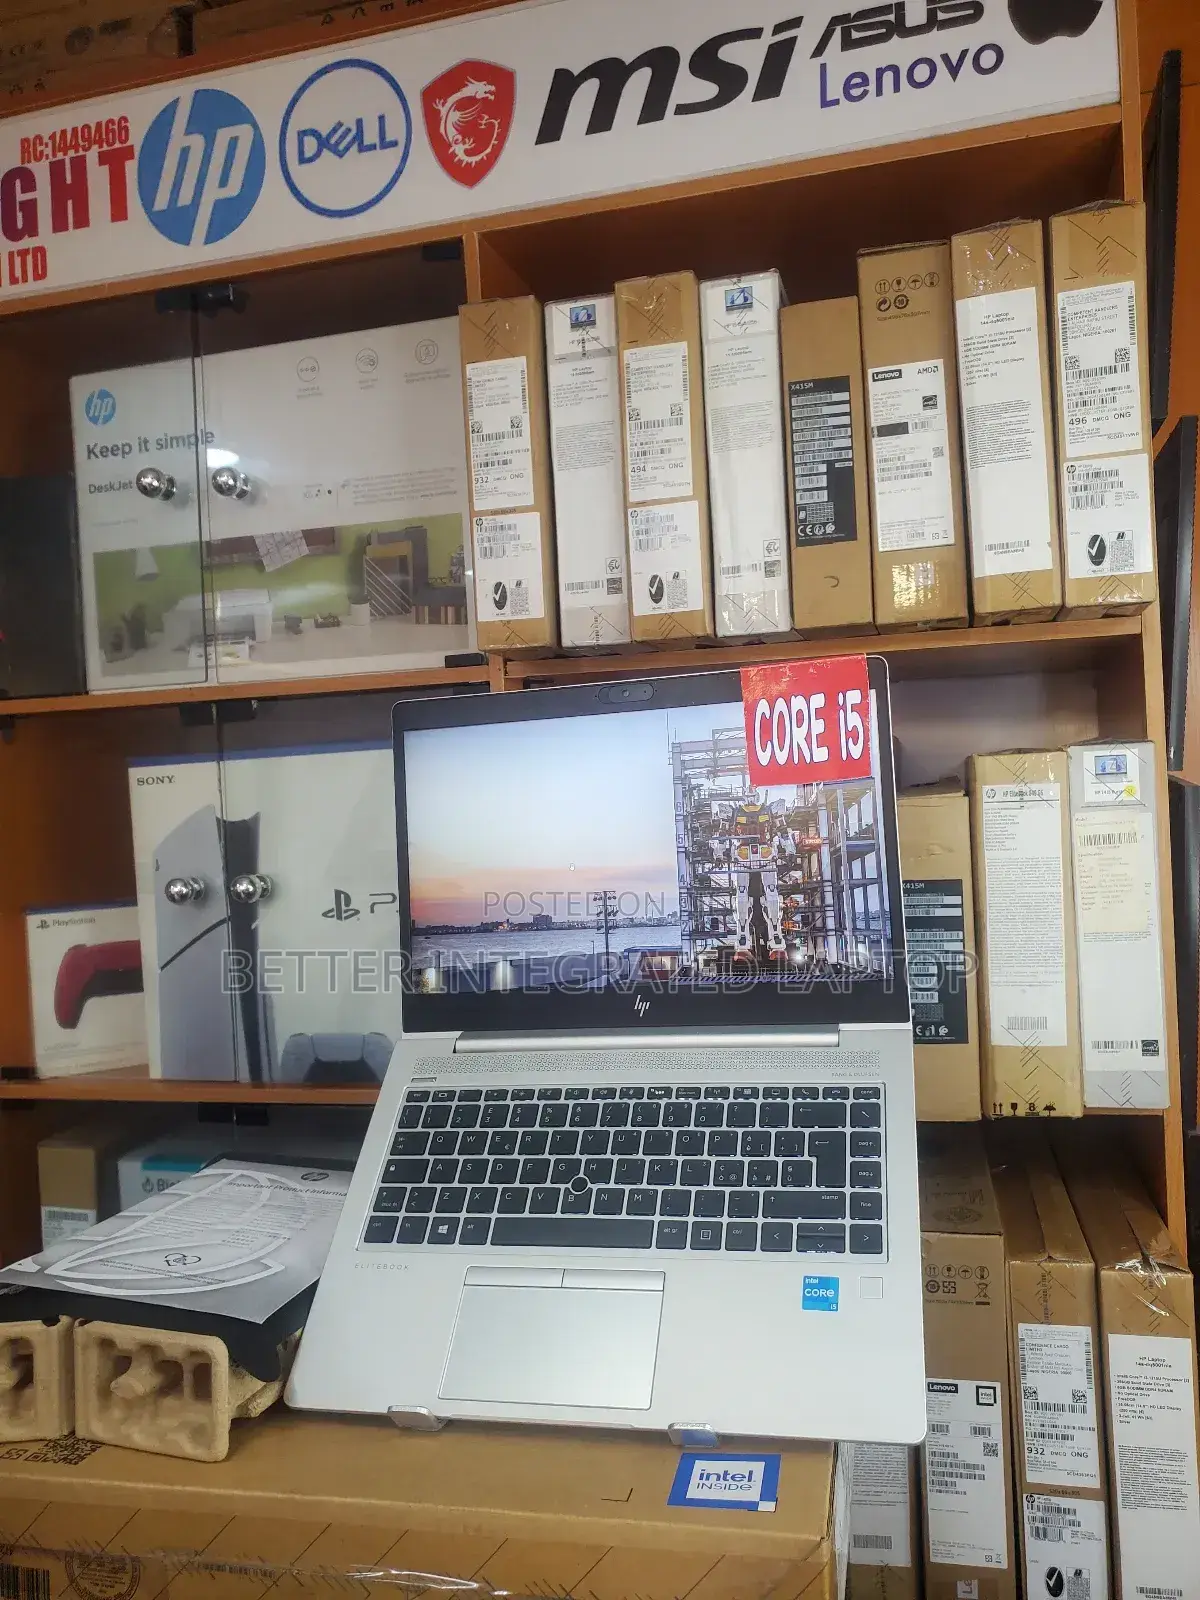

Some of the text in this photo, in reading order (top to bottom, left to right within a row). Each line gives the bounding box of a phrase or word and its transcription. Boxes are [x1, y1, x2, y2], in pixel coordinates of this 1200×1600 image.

[810, 0, 986, 59] ASUS
[534, 15, 803, 146] msi
[820, 43, 1004, 109] Lenovo
[20, 116, 130, 165] RC:1449466
[298, 113, 398, 167] DELL
[146, 89, 260, 246] hp
[8, 245, 48, 286] LTD
[873, 367, 932, 379] Lenovo AMD
[790, 382, 814, 390] X415M
[85, 389, 116, 425] hp
[1068, 416, 1088, 425] 496
[86, 429, 215, 460] Keep it simple
[631, 465, 646, 473] 494
[474, 476, 489, 484] 932
[88, 481, 133, 494] DeskJet
[753, 689, 864, 766] CORE i5
[136, 775, 175, 786] SONY
[52, 917, 97, 926] PlayStation
[436, 1135, 444, 1143] Q
[559, 1163, 566, 1171] G
[622, 1164, 627, 1172] J
[228, 1181, 273, 1190] Important
[274, 1185, 309, 1193] Product
[928, 1383, 956, 1391] Lenovo
[1026, 1446, 1045, 1455] 932
[698, 1470, 756, 1482] intel
